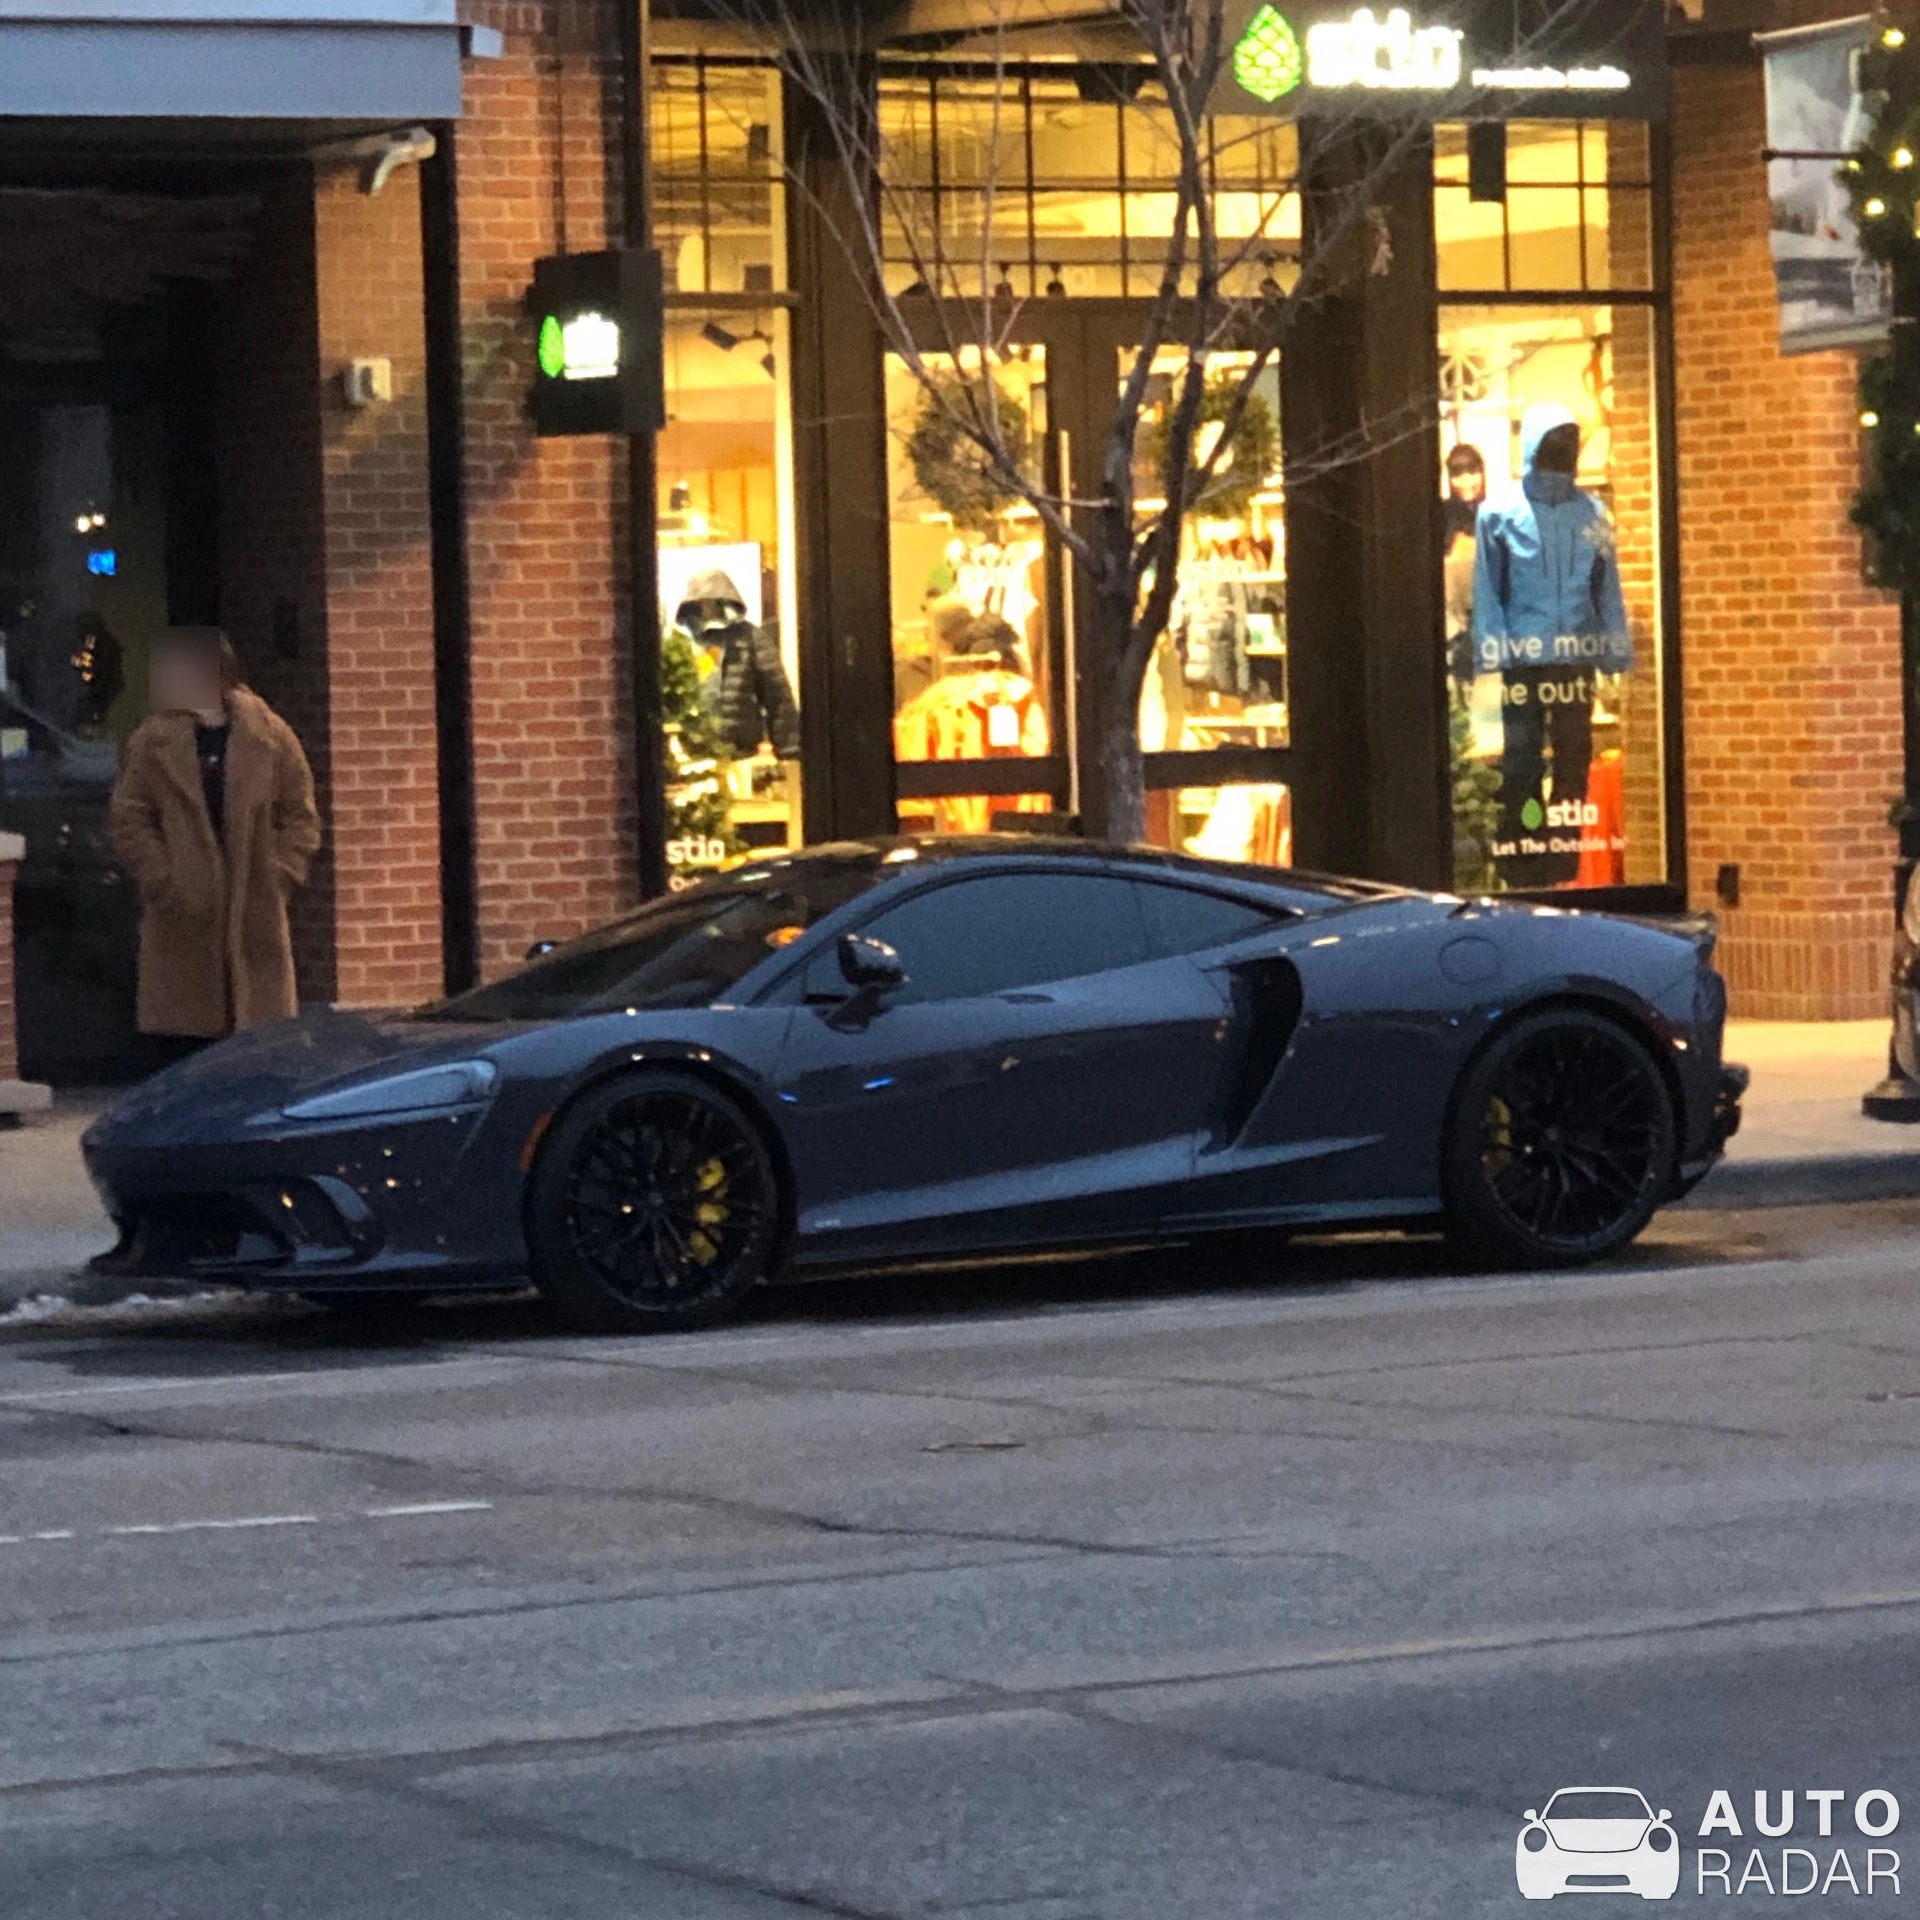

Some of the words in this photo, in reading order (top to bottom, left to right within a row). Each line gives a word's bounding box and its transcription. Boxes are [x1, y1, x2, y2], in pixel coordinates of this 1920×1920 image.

[1481, 631, 1543, 669] give
[1554, 634, 1629, 657] more
[1546, 799, 1599, 827] stio
[665, 834, 725, 864] stio
[1492, 840, 1516, 856] Let
[1520, 838, 1546, 854] The
